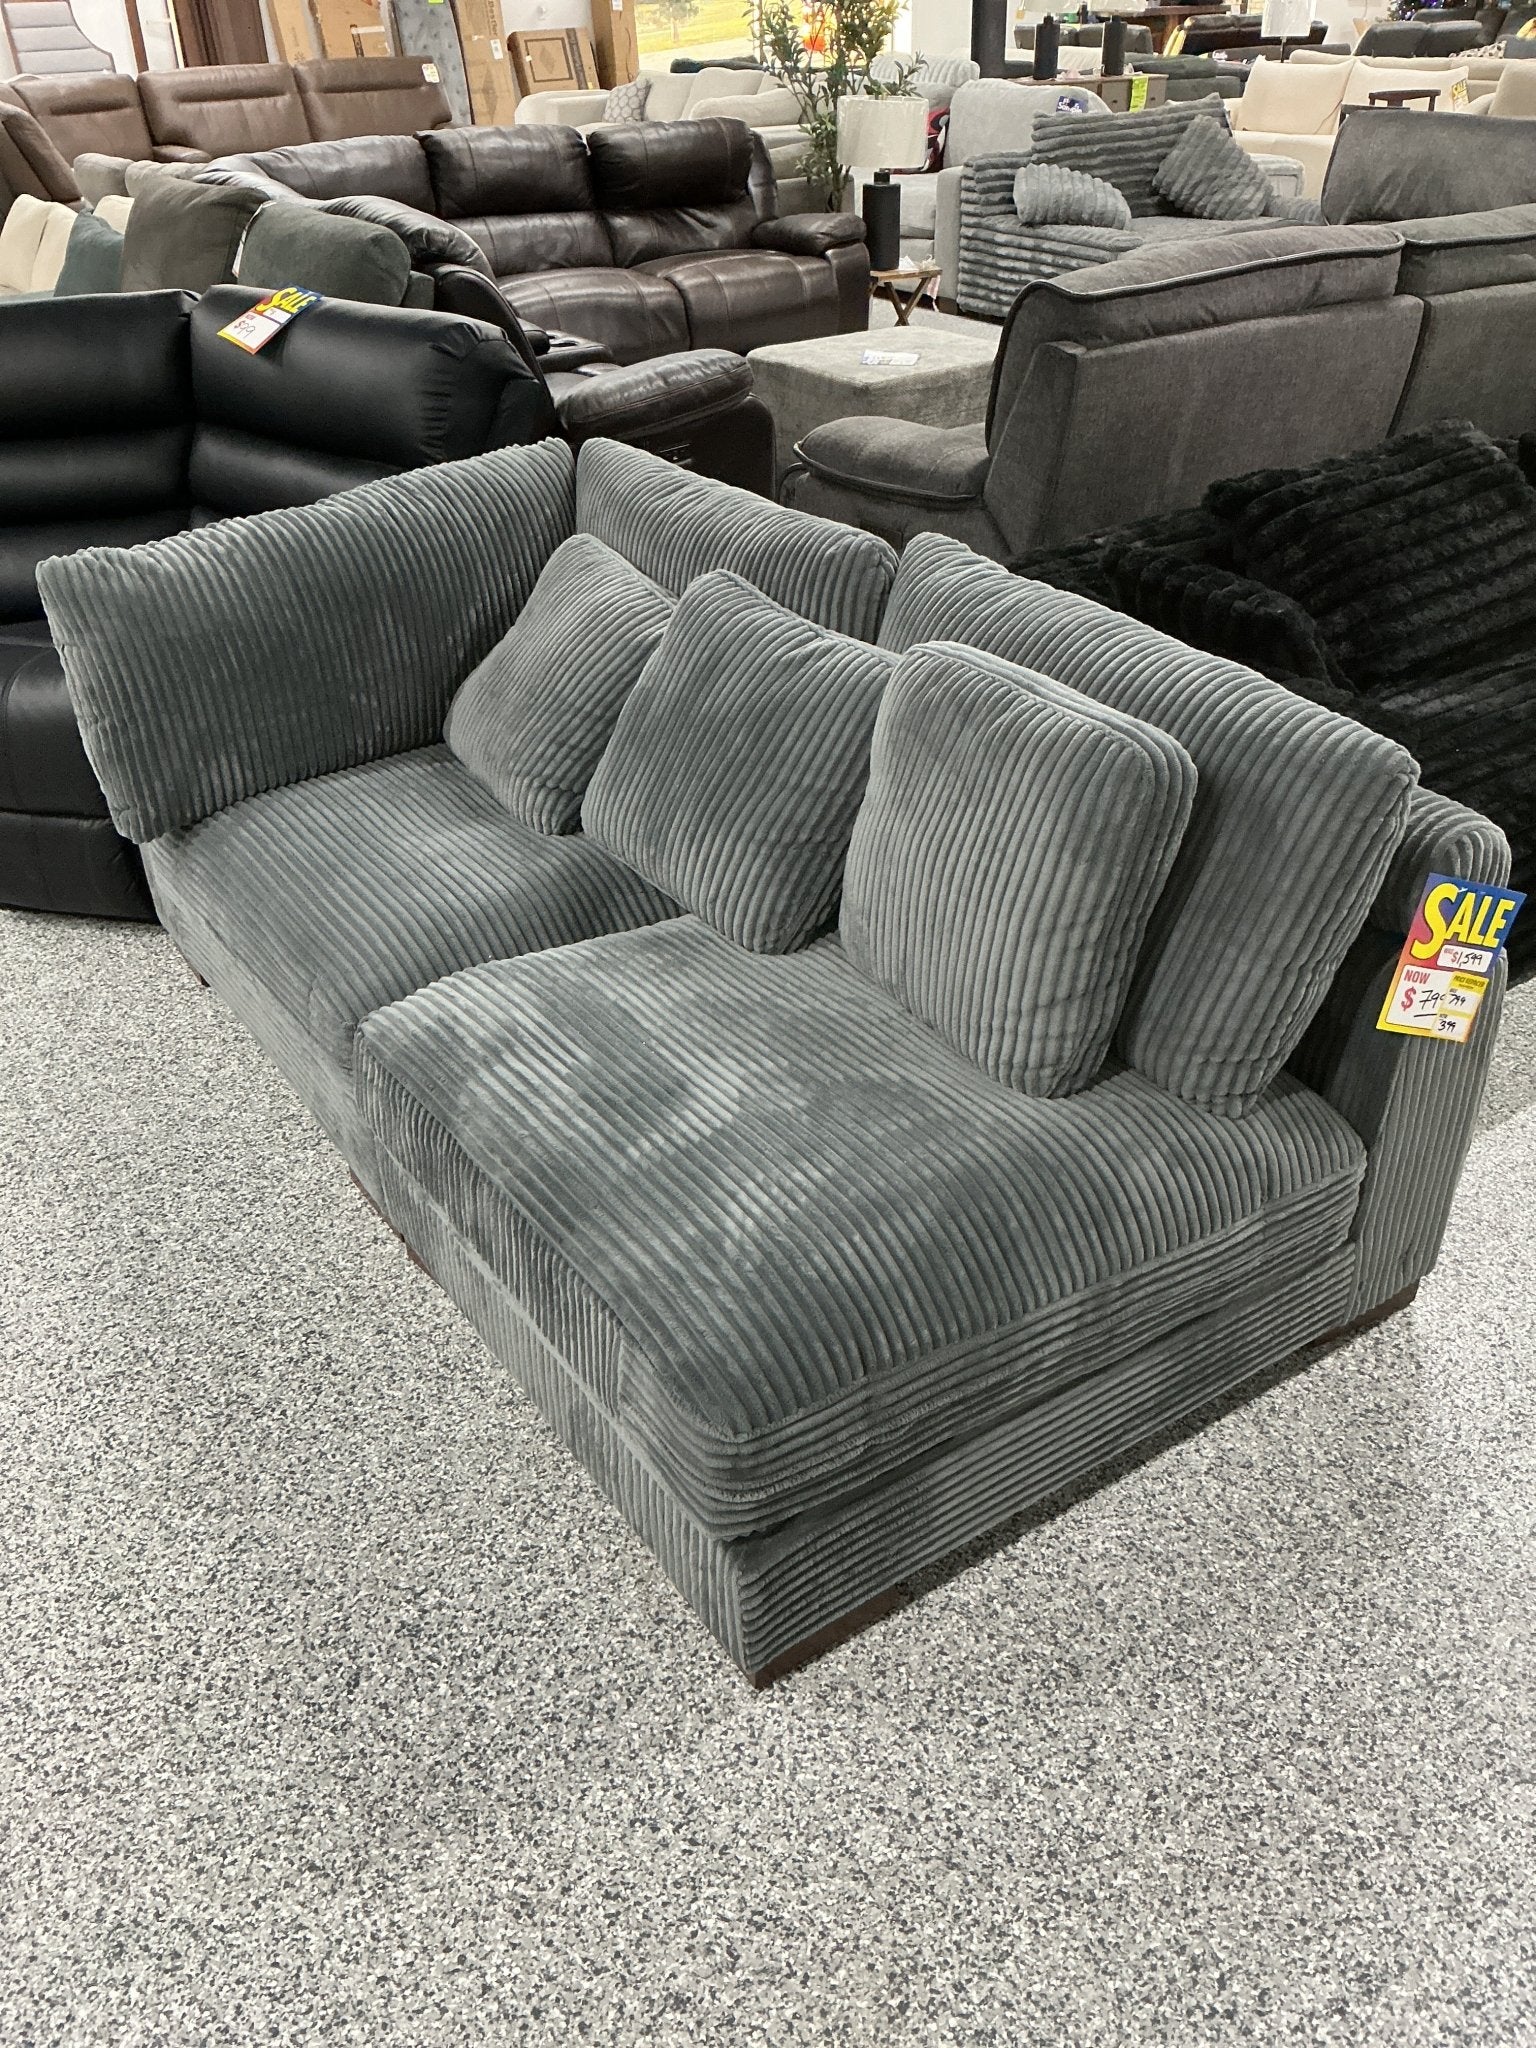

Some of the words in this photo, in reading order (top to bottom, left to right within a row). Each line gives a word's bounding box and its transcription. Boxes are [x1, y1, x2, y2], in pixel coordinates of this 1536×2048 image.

[255, 287, 317, 314] SALE
[1411, 882, 1516, 960] SALE
[1404, 970, 1431, 985] NOW
[1438, 1020, 1456, 1033] 399
